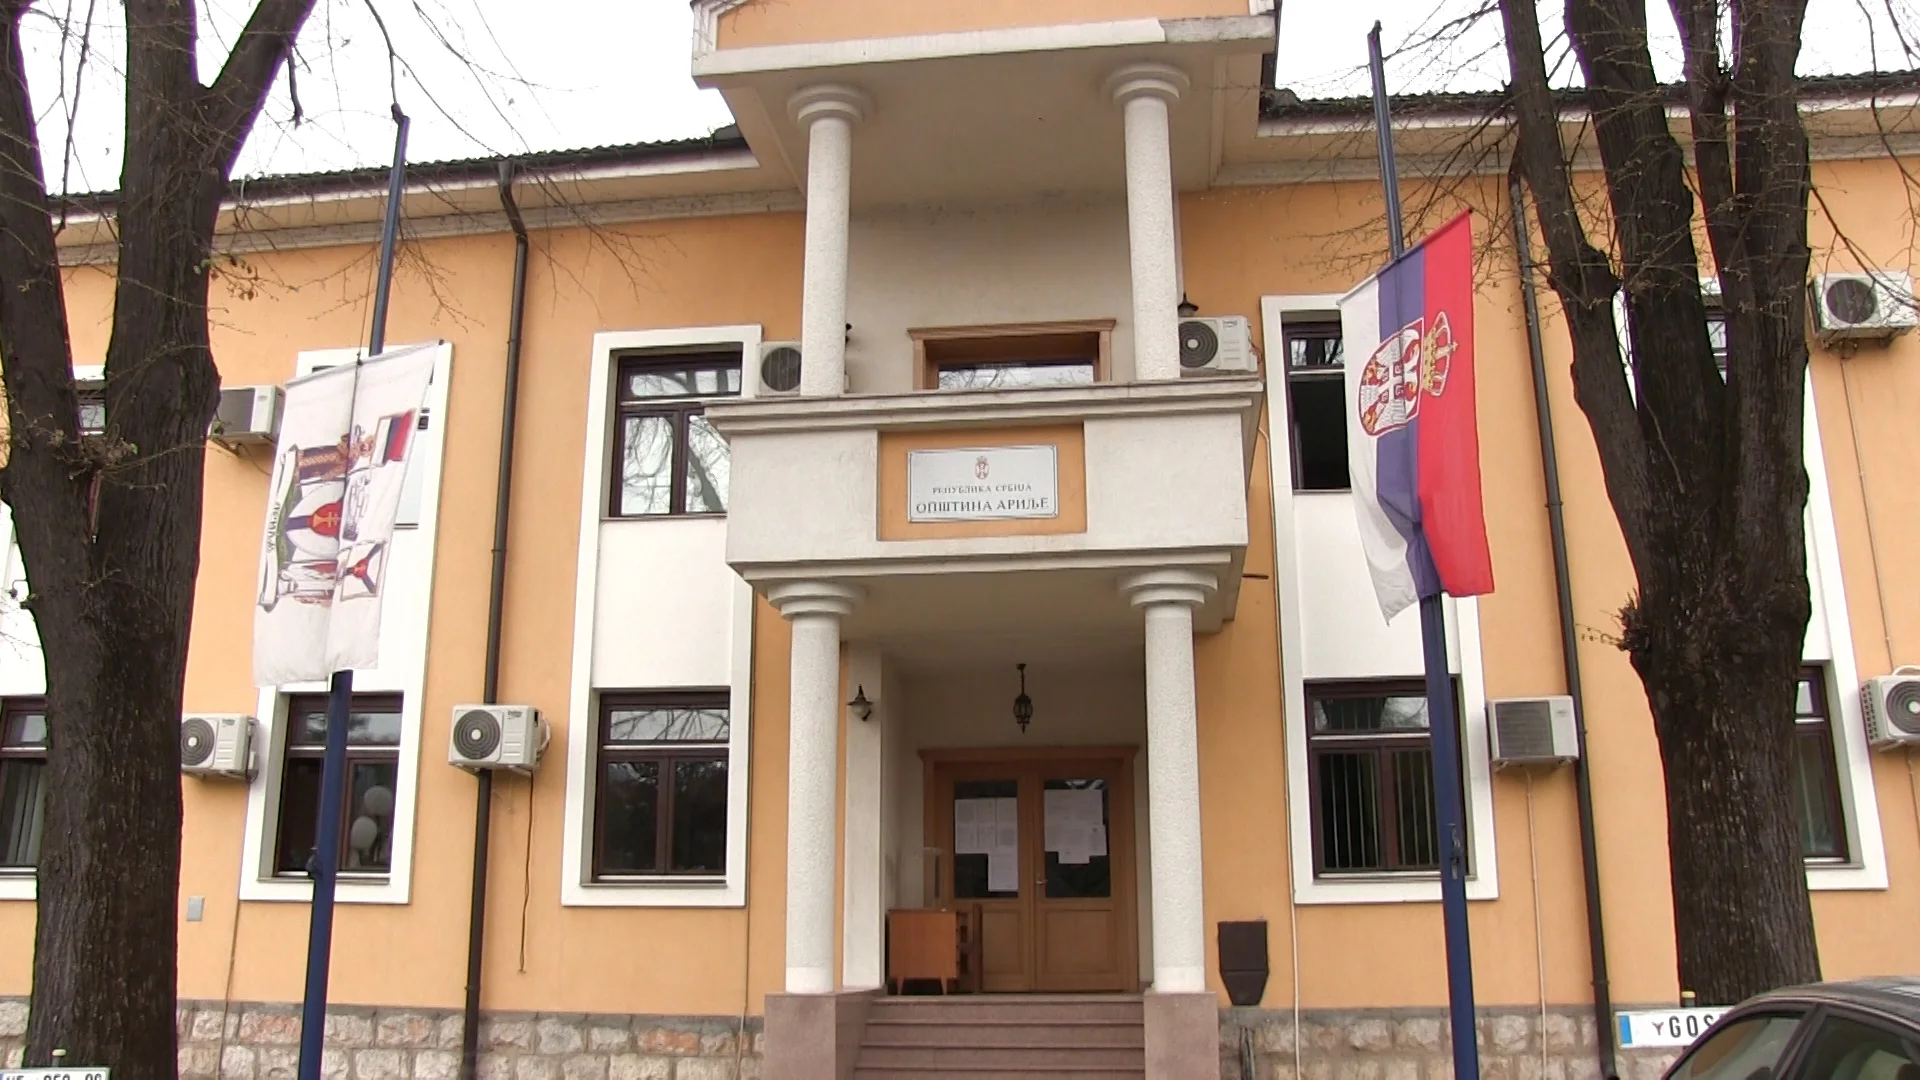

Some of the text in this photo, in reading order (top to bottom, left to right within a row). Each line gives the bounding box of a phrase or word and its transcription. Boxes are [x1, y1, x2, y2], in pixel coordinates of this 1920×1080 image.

[932, 483, 1032, 495] РЕПУБЛИКА СРБИЈА
[916, 497, 1050, 514] ОПШТИНА АРИЉЕ
